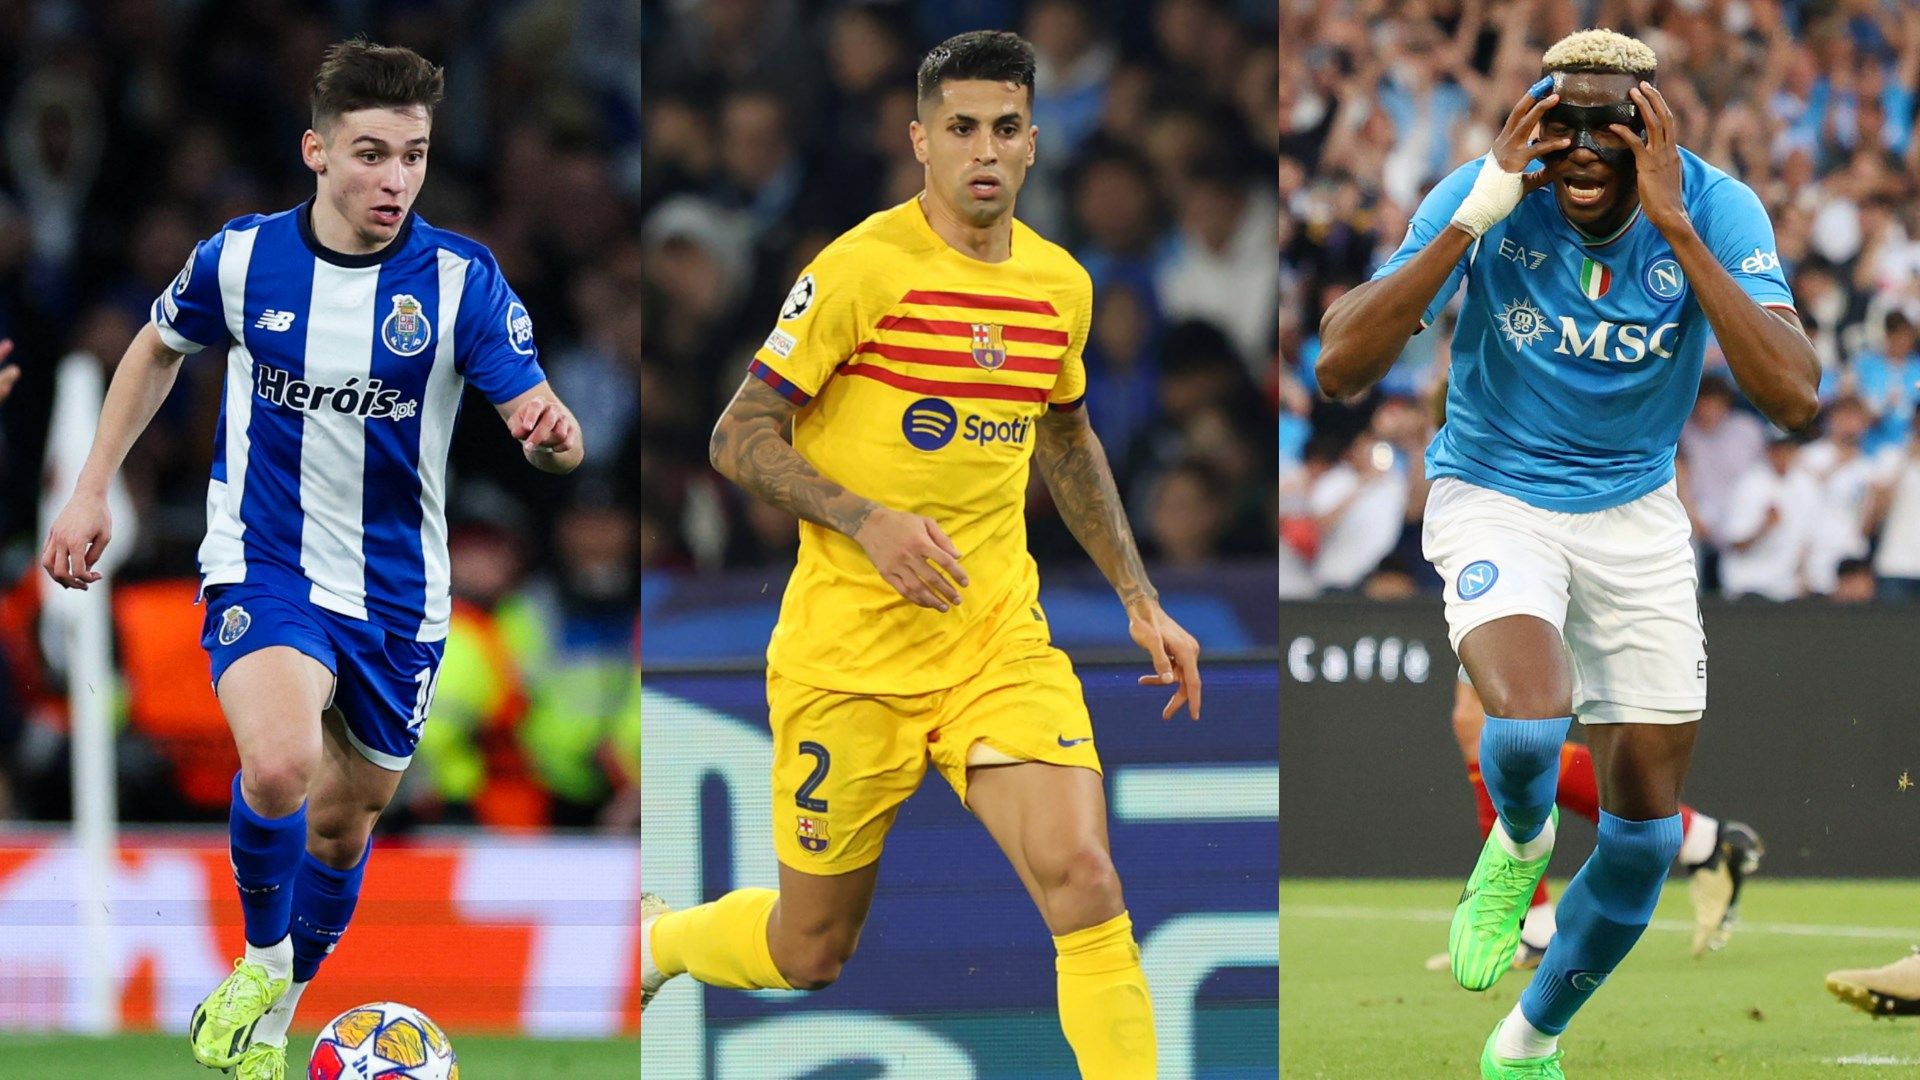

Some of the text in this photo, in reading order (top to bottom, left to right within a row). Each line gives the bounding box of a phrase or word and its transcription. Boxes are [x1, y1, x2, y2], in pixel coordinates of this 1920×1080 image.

[1499, 237, 1548, 270] EA7
[1654, 265, 1677, 291] N
[1553, 315, 1680, 363] MSC
[963, 414, 1031, 447] Spoti
[1465, 567, 1485, 591] N
[795, 741, 831, 814] 2
